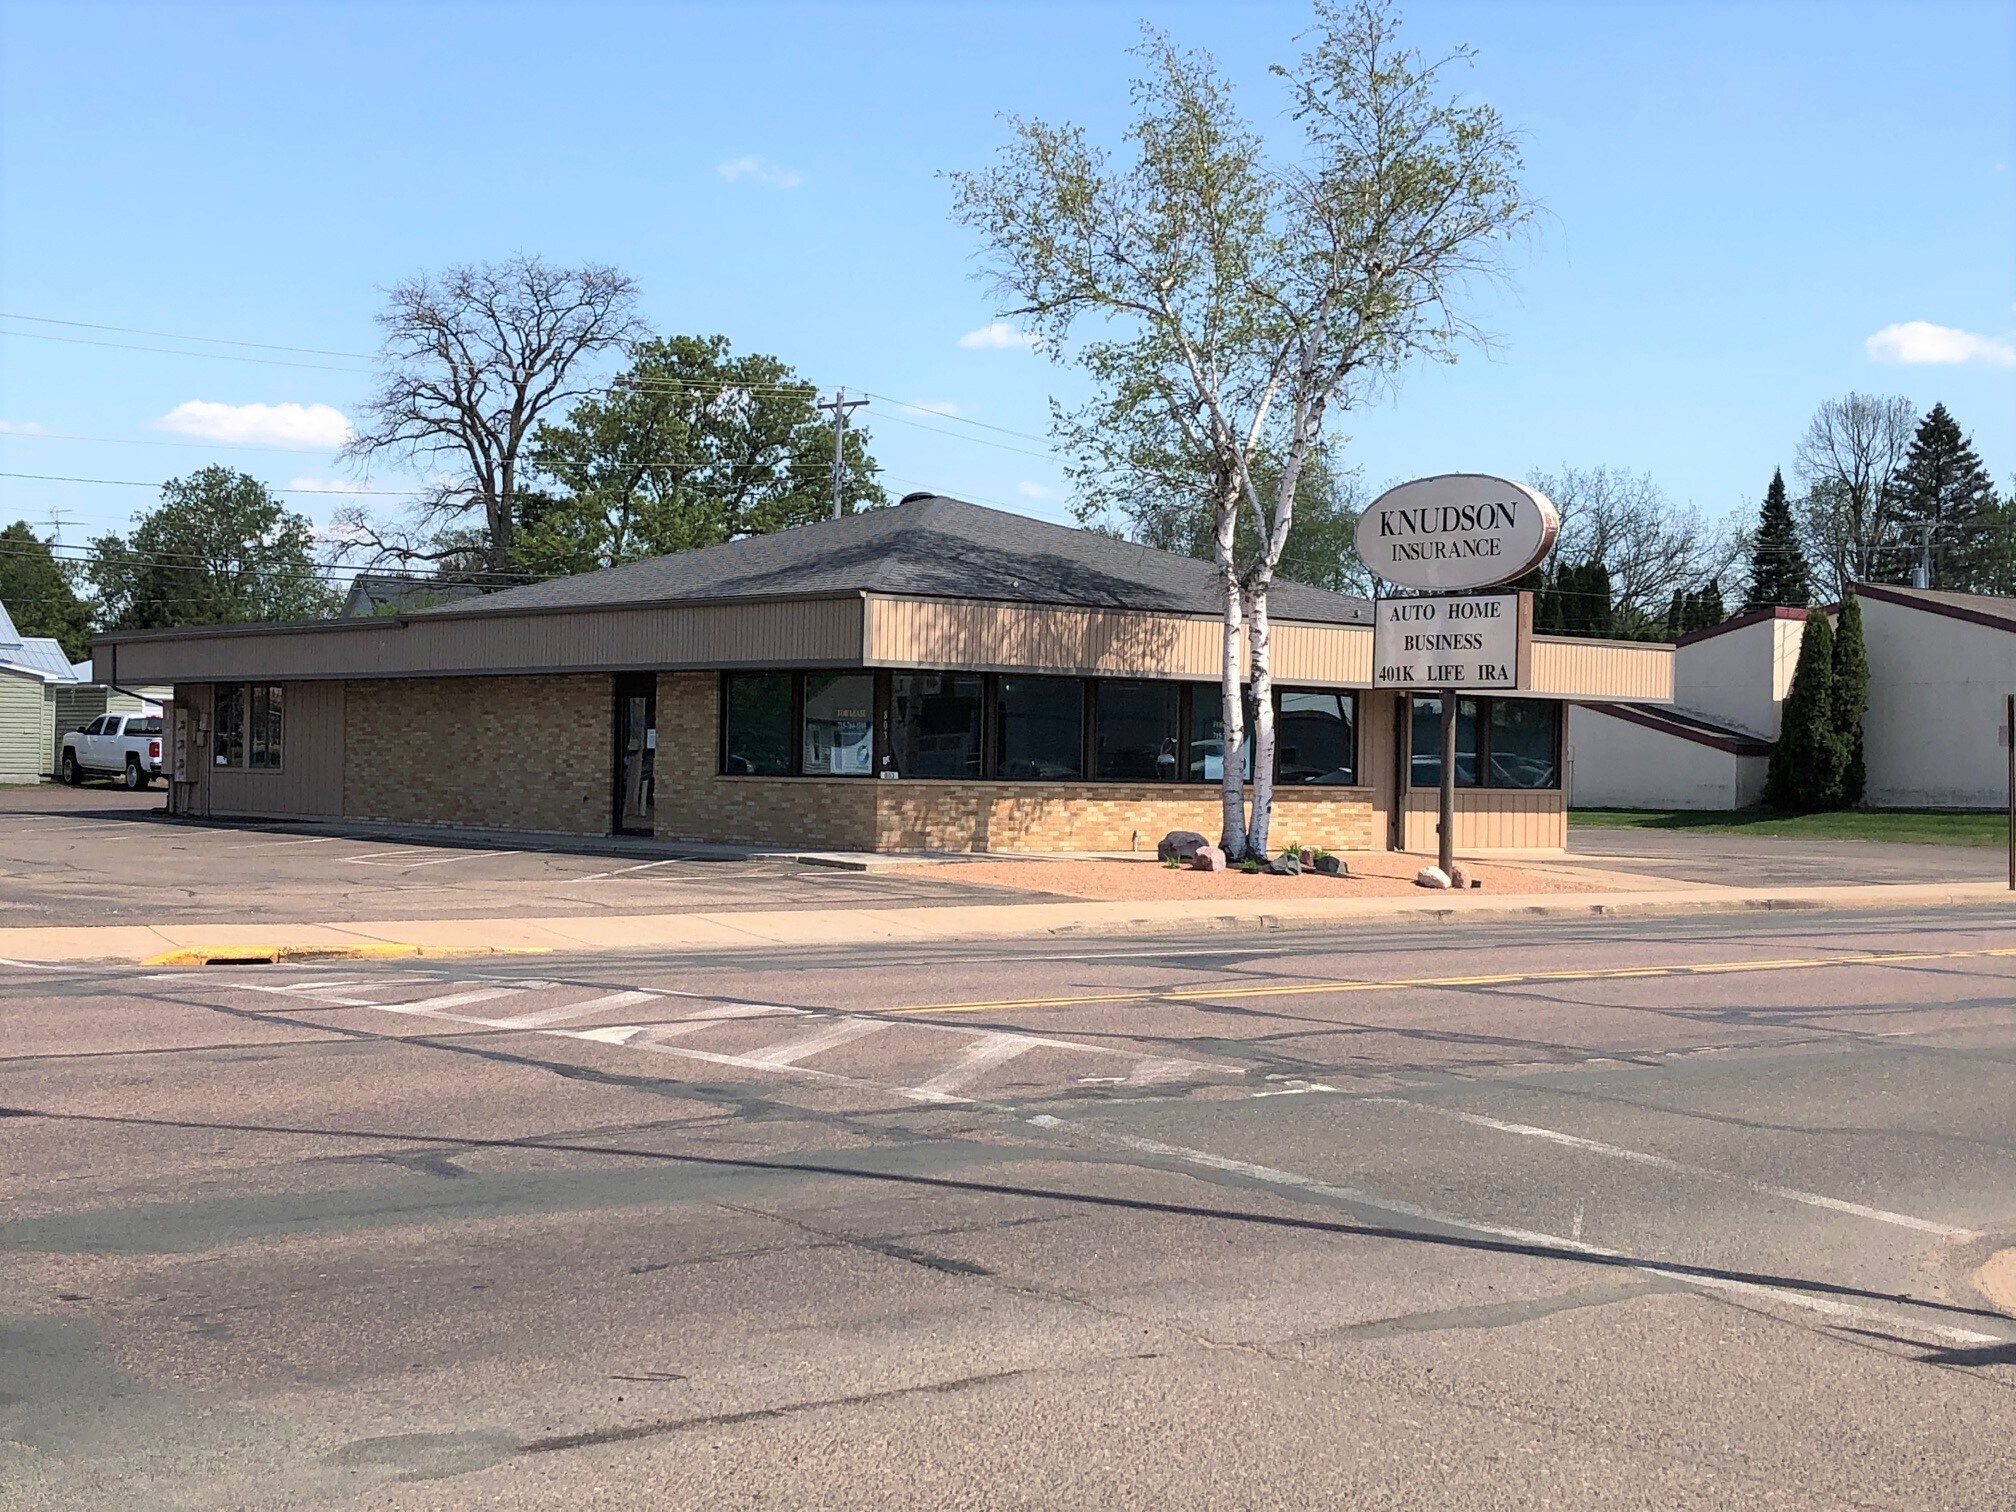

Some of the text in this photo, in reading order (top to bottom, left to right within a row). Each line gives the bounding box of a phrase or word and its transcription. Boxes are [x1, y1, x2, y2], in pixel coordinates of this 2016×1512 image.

[1379, 502, 1518, 537] KNUDSON
[1391, 538, 1502, 561] INSURANCE
[1390, 602, 1502, 622] AUTO HOME
[1404, 633, 1483, 651] BUSINESS
[1379, 664, 1509, 682] 401K LIFE IRA
